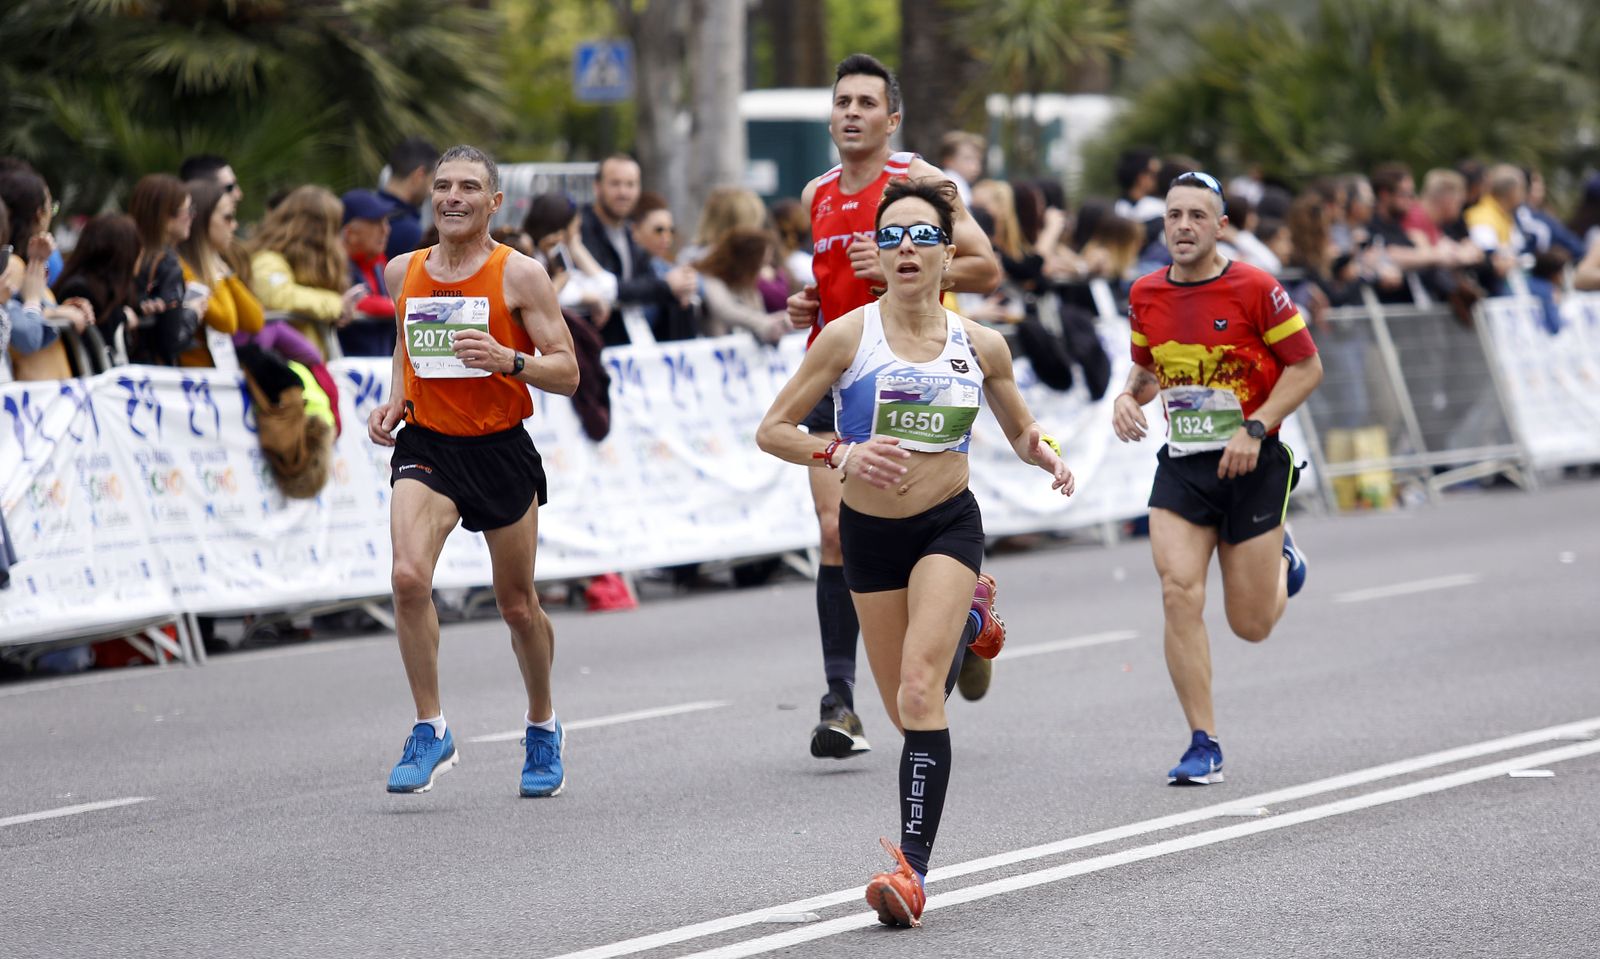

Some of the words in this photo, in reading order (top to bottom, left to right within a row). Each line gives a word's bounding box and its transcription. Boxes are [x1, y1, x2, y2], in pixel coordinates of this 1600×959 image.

[886, 411, 944, 433] 1650
[1175, 415, 1214, 435] 1324
[905, 752, 937, 835] kalenji
